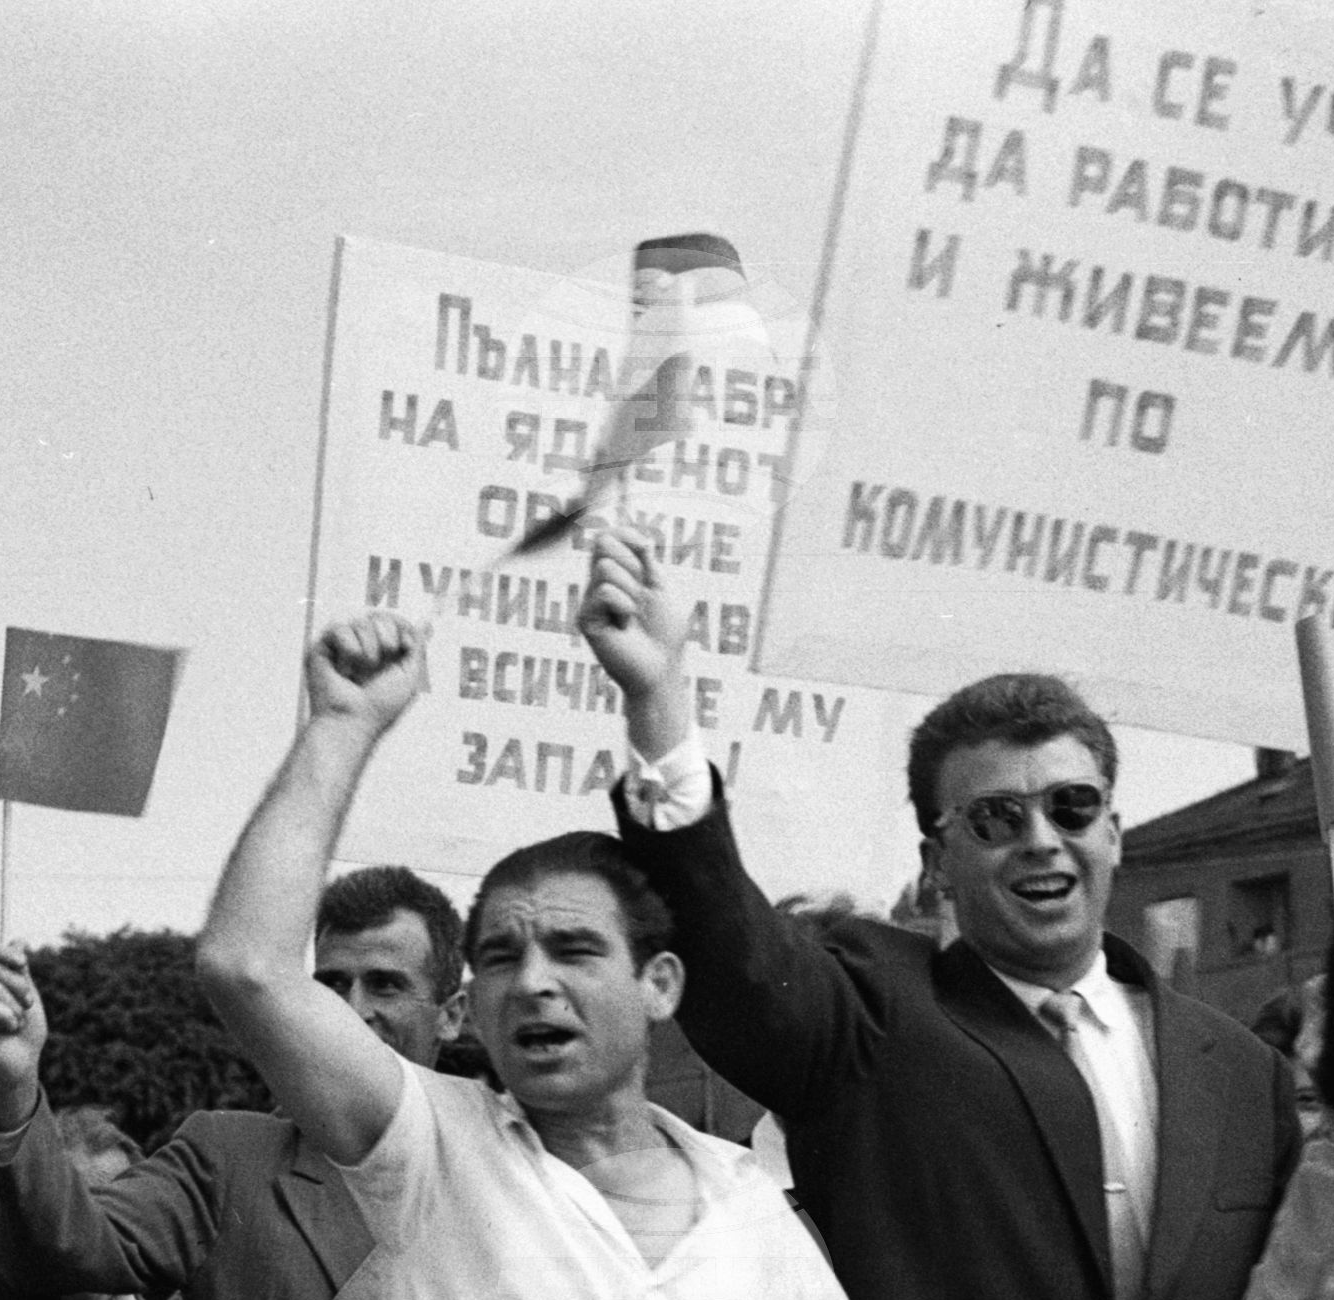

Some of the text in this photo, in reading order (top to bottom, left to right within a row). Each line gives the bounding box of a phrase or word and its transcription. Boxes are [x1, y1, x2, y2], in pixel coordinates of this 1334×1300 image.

[992, 0, 1112, 114] ДА
[1152, 50, 1238, 131] СЕ
[924, 116, 1028, 201] ДА
[907, 228, 962, 298] И
[434, 293, 614, 399] ПЪЛНА
[378, 389, 460, 452] НА
[1079, 378, 1177, 455] ПО
[366, 555, 402, 609] И
[752, 687, 847, 743] МУ
